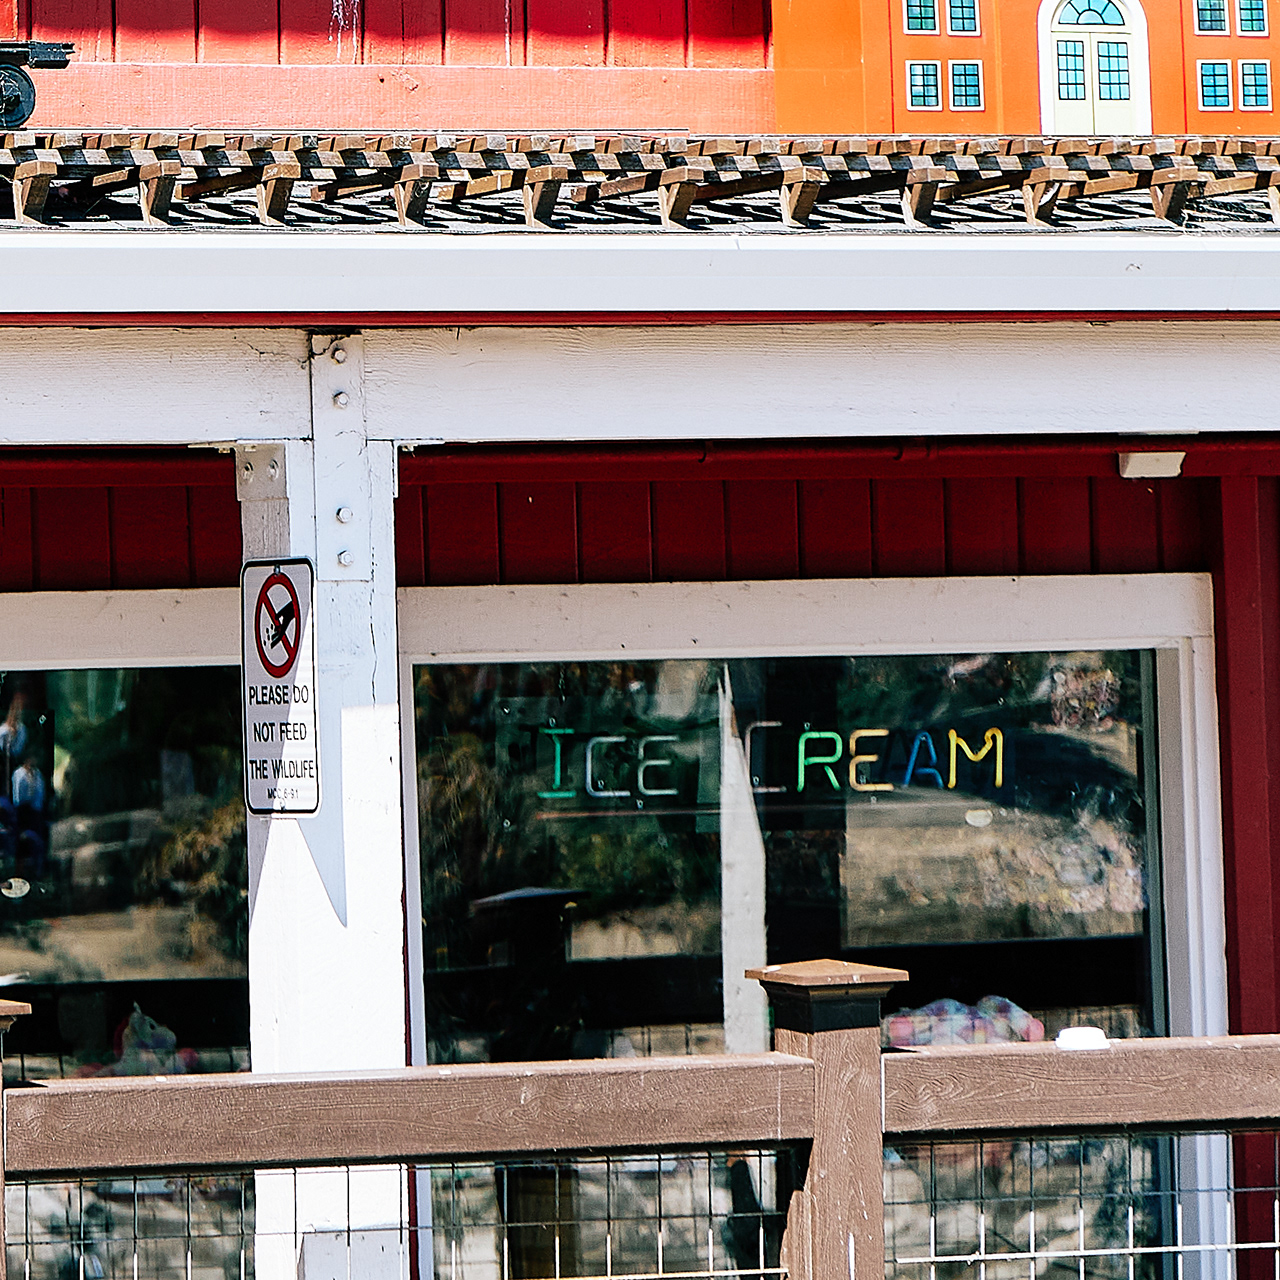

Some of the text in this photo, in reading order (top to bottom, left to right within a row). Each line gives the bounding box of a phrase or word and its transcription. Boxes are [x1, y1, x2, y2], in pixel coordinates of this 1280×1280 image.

[248, 684, 309, 705] PLEASE DO
[253, 722, 307, 743] NOT FEED
[248, 759, 315, 780] THE WILDLIFE
[538, 720, 1005, 799] ICE CREAM
